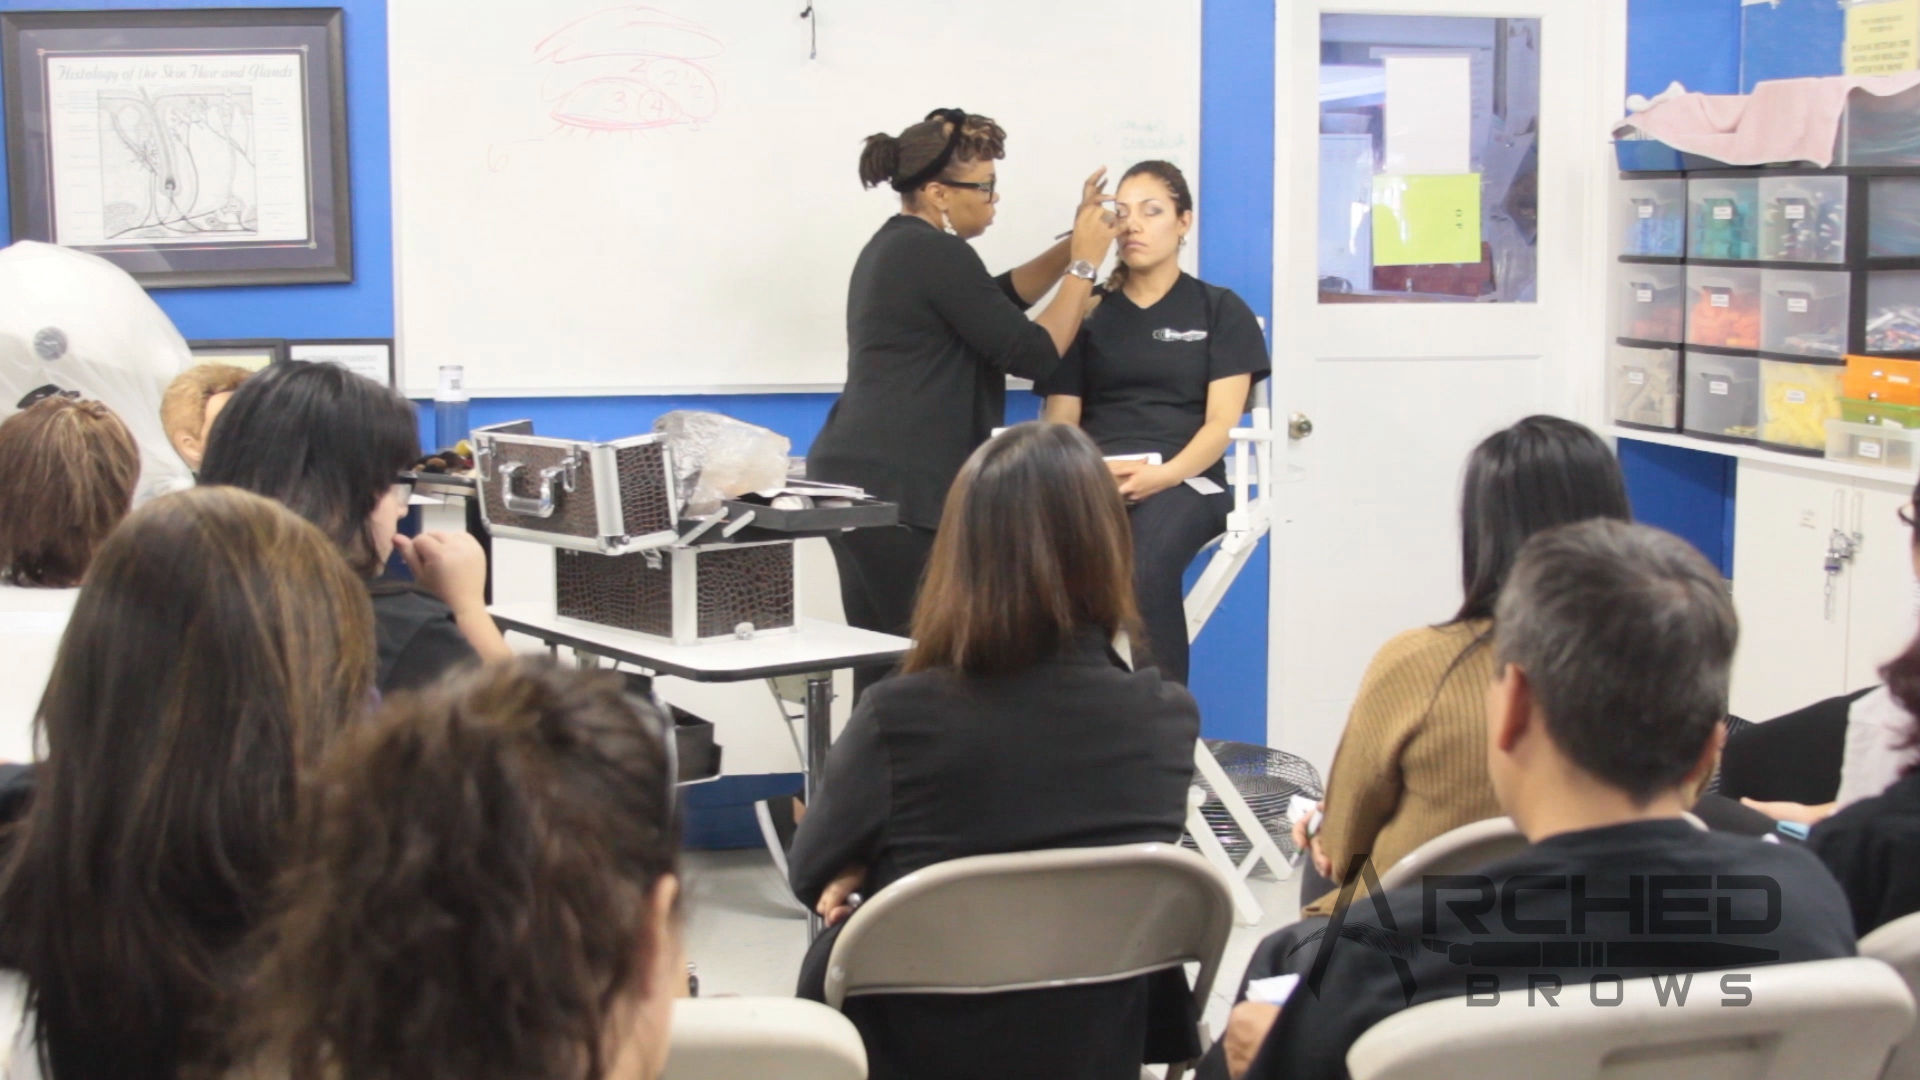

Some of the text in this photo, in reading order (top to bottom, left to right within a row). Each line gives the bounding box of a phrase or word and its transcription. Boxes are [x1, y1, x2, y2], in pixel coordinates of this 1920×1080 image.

[121, 64, 135, 80] of
[137, 64, 158, 80] the
[221, 64, 246, 79] and
